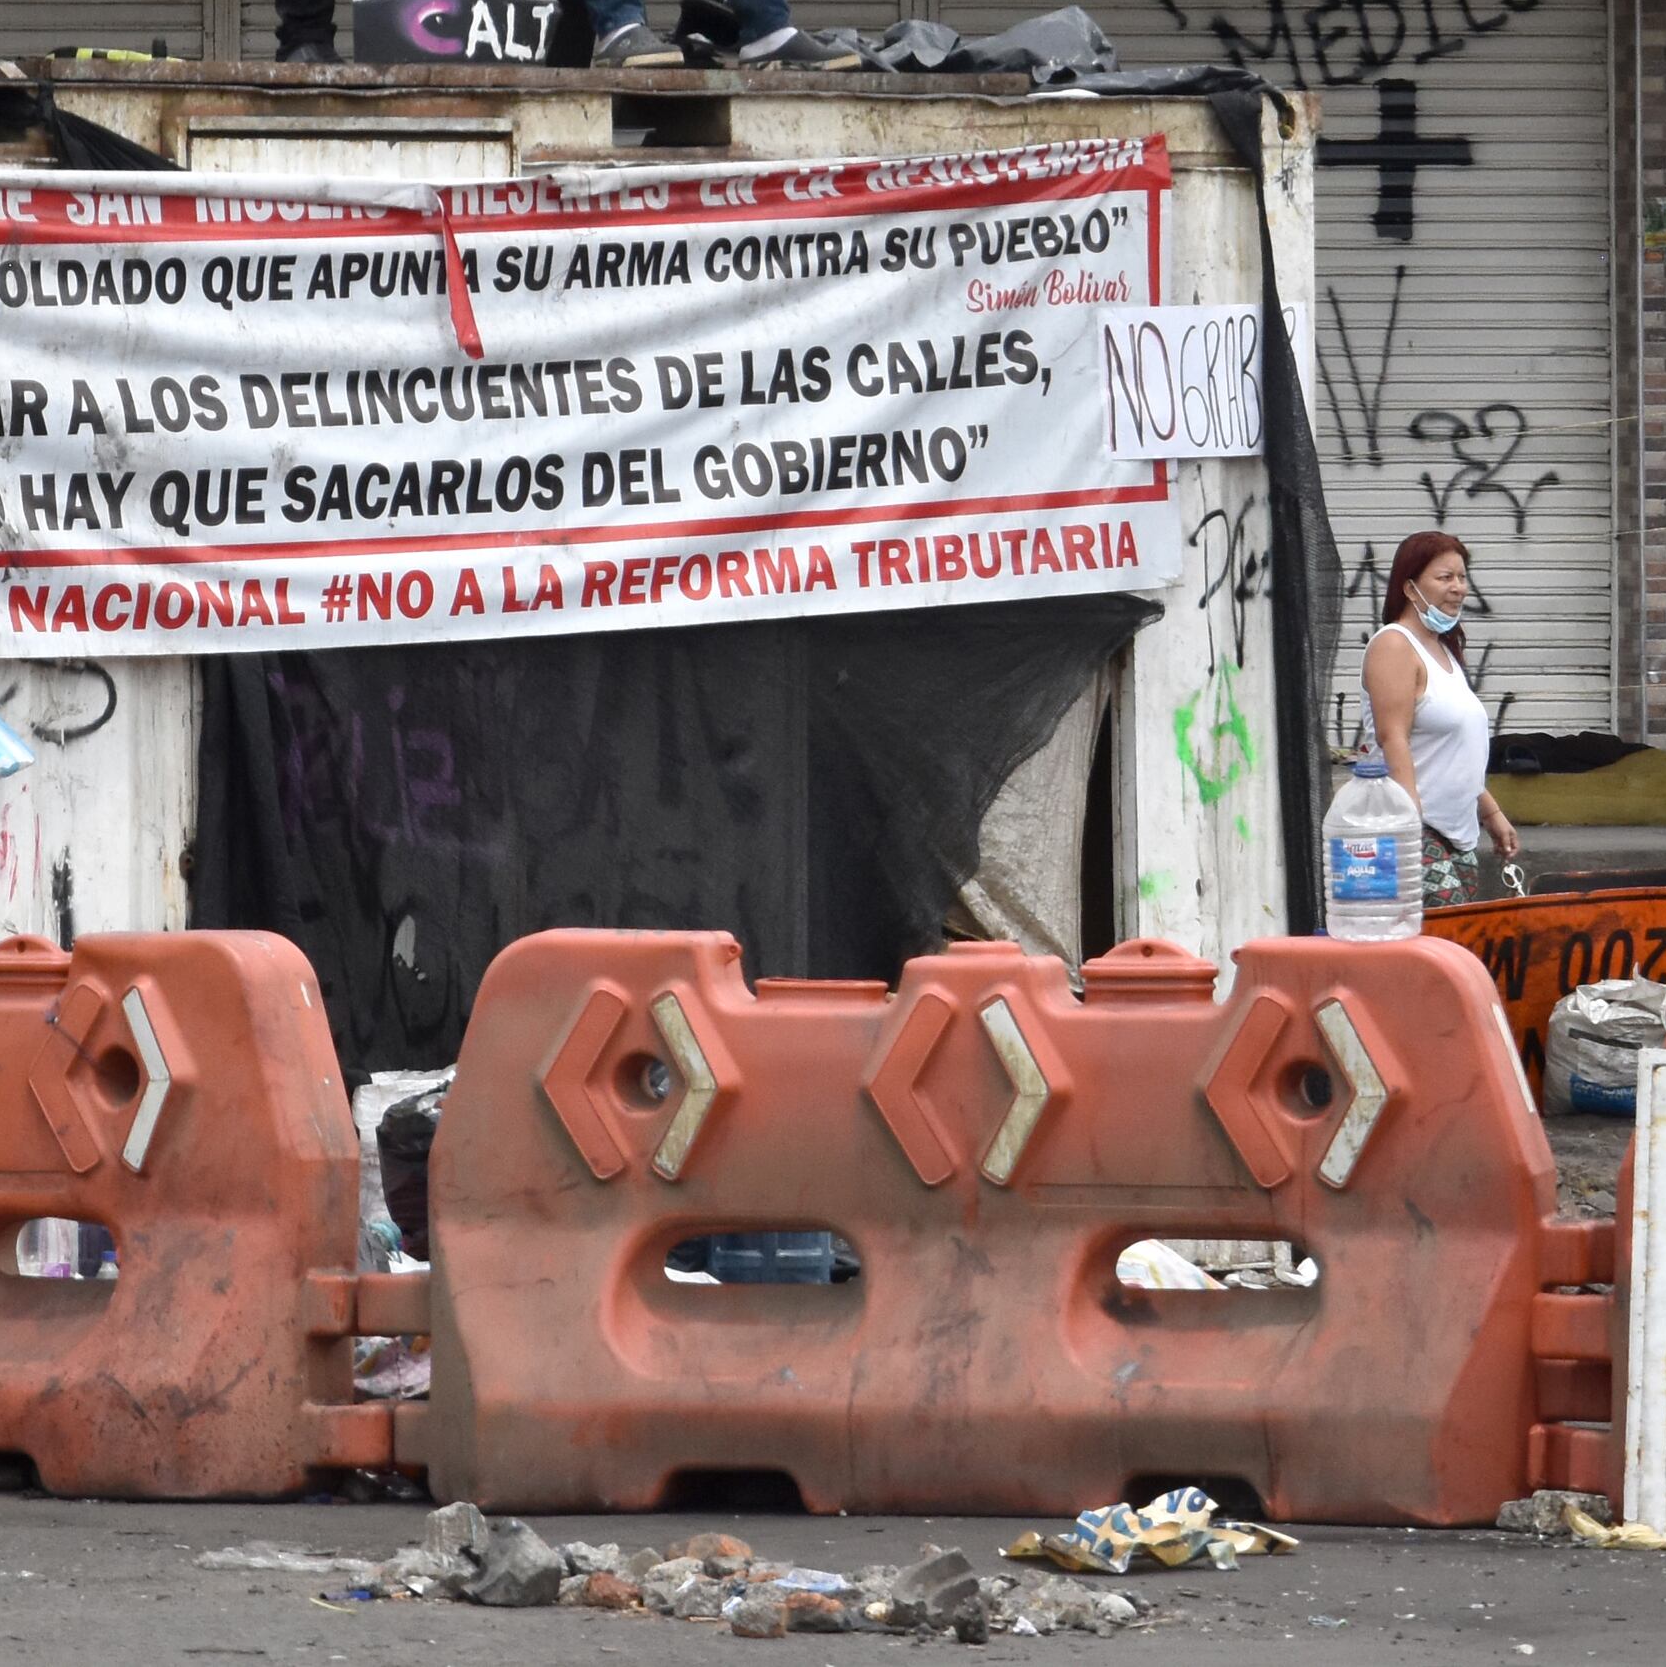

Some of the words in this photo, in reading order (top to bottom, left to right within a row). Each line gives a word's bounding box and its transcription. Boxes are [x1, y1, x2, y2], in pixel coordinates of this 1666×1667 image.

[201, 254, 297, 311] QUE
[492, 245, 554, 294] SU
[564, 238, 692, 291] ARMA
[704, 229, 869, 284] CONTRA
[879, 225, 936, 273] SU
[965, 278, 1040, 314] Simón
[68, 378, 108, 436] A
[123, 373, 228, 434] LOS
[241, 355, 644, 432] DELINCUENTES
[659, 351, 726, 411] DE
[739, 344, 833, 406] LAS
[846, 330, 1054, 399] CALLES,
[1104, 320, 1176, 452] NO
[1180, 307, 1296, 449] GRAB
[21, 470, 136, 531] HAY
[149, 465, 267, 529] QUE
[282, 451, 566, 524] SACARLOS
[581, 446, 681, 509] DEL
[8, 575, 306, 634] NACIONAL
[320, 566, 435, 625] #NO
[449, 565, 486, 616] A
[501, 560, 565, 613] LA
[580, 540, 839, 609] REFORMA
[855, 520, 1140, 589] TRIBUTARIA
[1346, 864, 1376, 878] Agua
